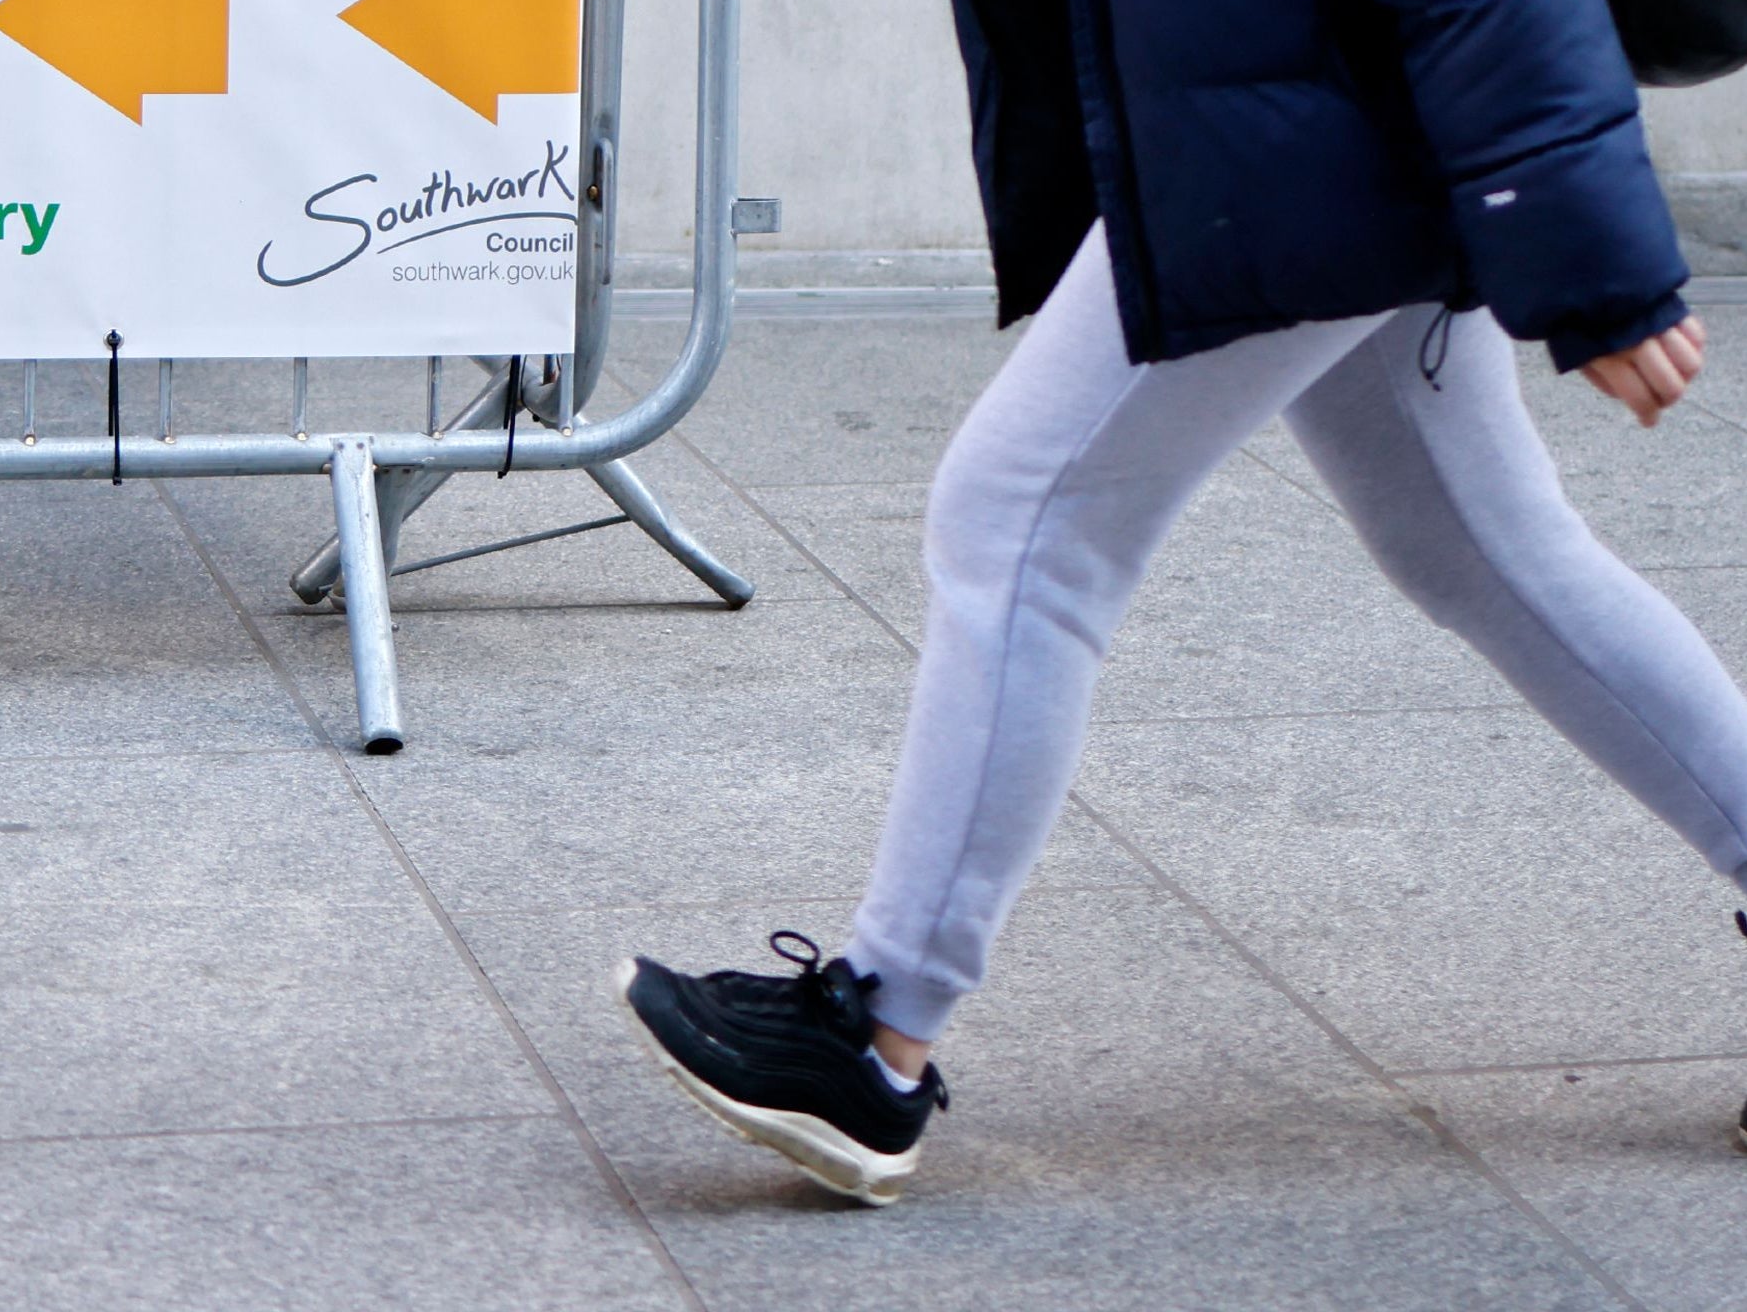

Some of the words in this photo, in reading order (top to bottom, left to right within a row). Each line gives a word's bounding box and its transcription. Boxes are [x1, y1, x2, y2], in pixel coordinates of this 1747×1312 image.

[257, 140, 576, 287] Southwark
[486, 233, 575, 253] Council
[392, 261, 575, 285] southwark.gov.uk
